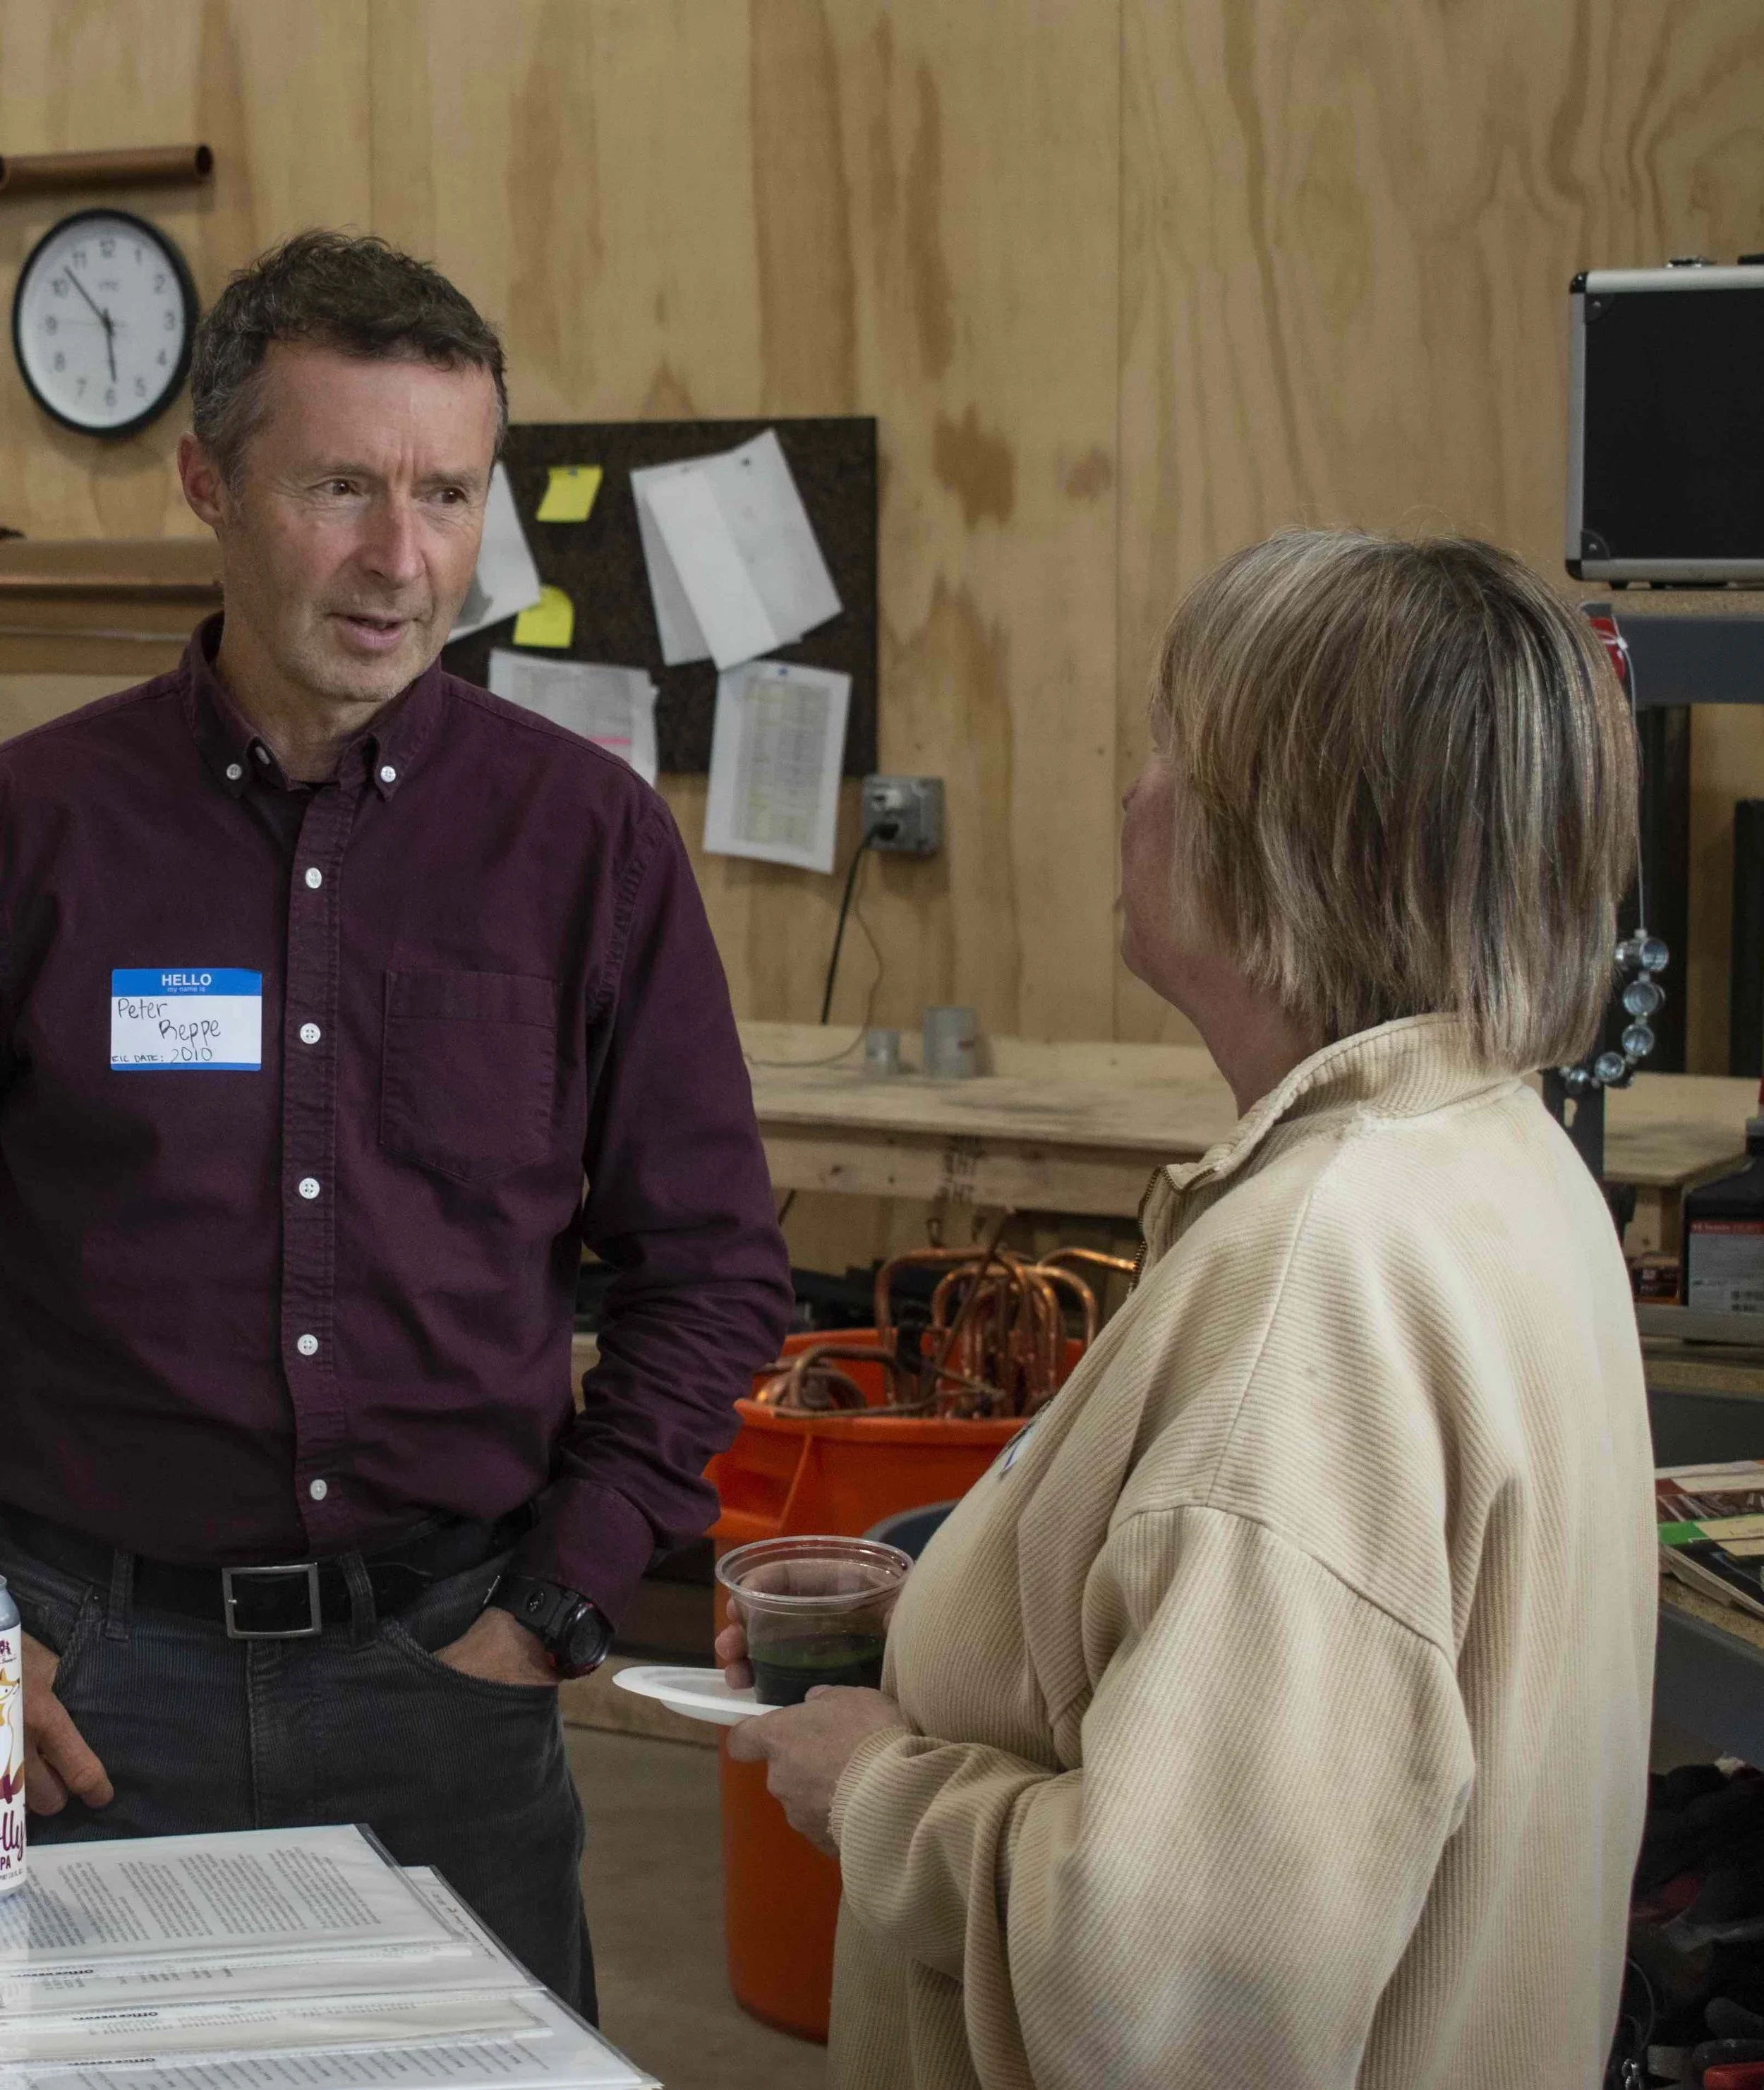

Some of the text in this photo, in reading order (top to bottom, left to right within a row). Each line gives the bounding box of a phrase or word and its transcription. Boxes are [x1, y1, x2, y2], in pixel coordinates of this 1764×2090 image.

[99, 238, 116, 258] 12
[135, 247, 143, 265] 1
[72, 250, 87, 269] 11
[52, 279, 69, 298] 10
[153, 272, 167, 294] 2
[45, 315, 59, 336] 9
[164, 309, 176, 331] 3
[54, 352, 66, 373] 8
[157, 349, 167, 366] 4
[75, 377, 87, 397] 7
[134, 376, 146, 397] 5
[105, 387, 116, 407] 6
[162, 973, 212, 986] HELLO
[118, 998, 168, 1019] Peter
[135, 1054, 164, 1063] DATE:
[170, 1047, 212, 1063] 2010
